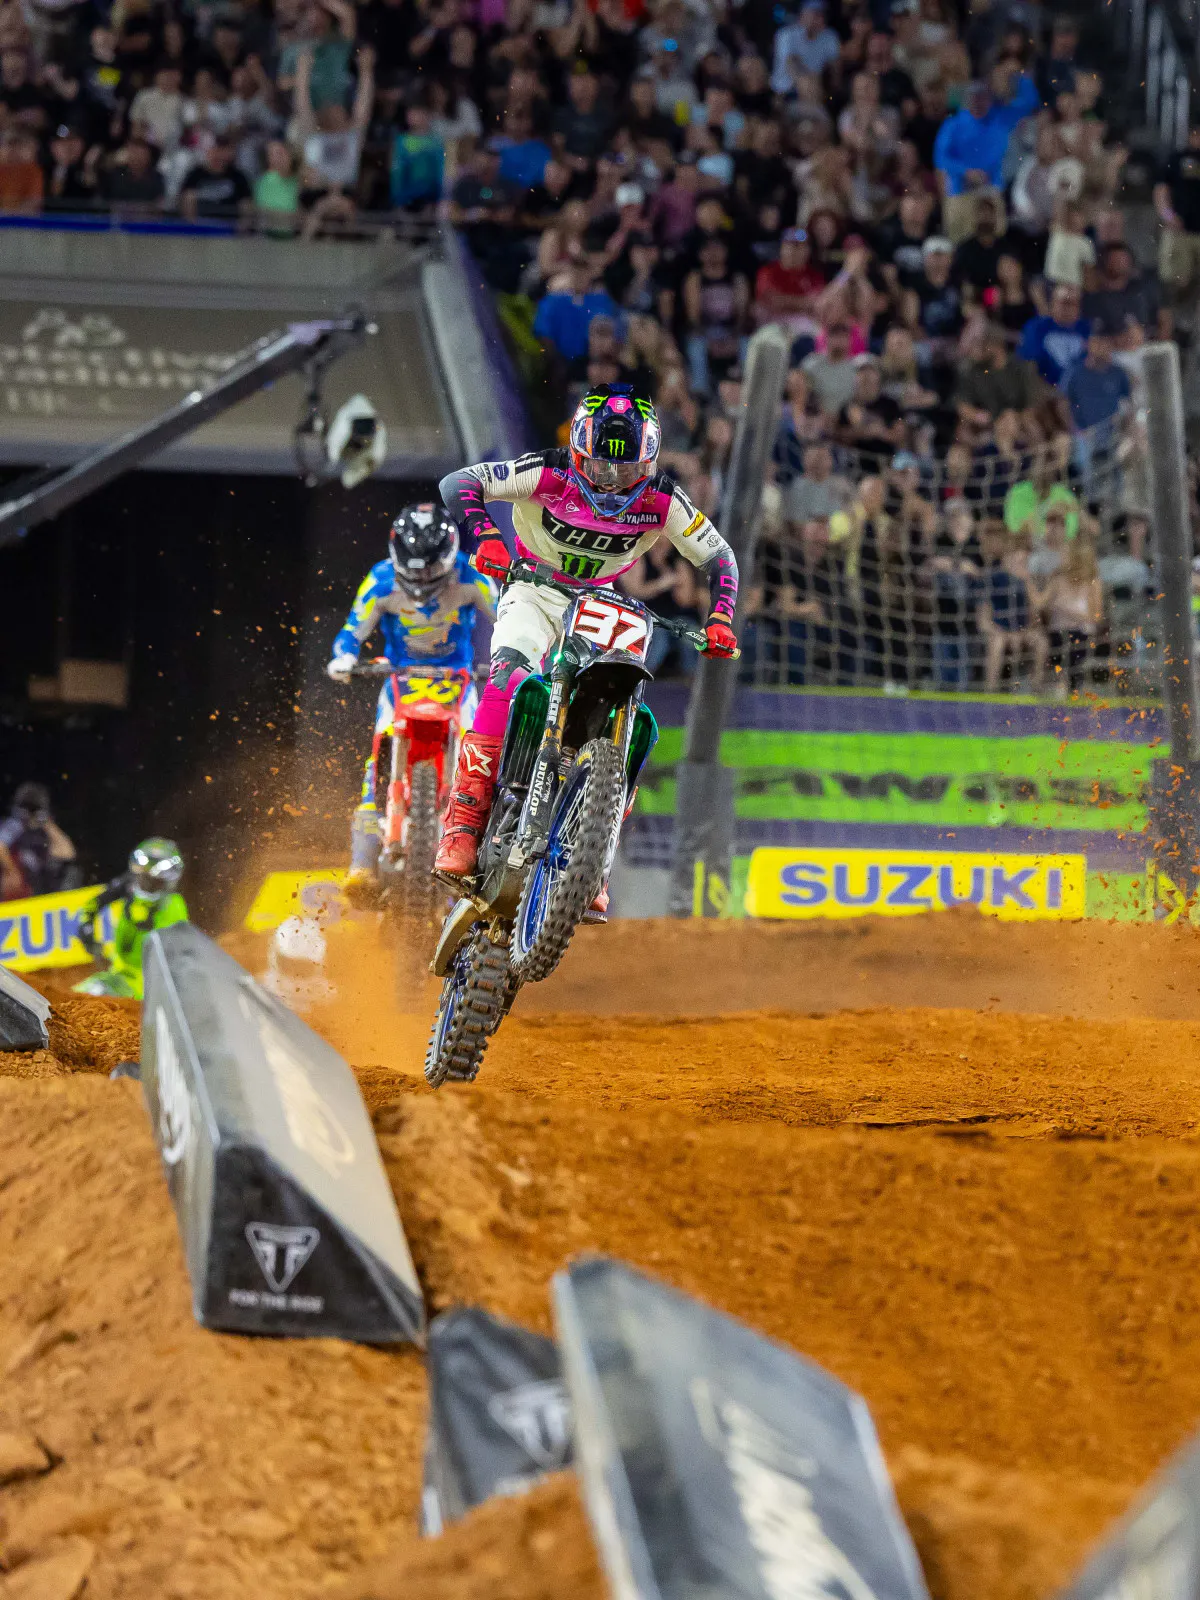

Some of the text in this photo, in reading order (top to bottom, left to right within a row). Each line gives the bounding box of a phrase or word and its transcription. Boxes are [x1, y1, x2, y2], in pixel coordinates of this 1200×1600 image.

[574, 600, 647, 650] 37
[529, 760, 548, 816] DUNLOP
[780, 864, 1061, 909] SUZUKI
